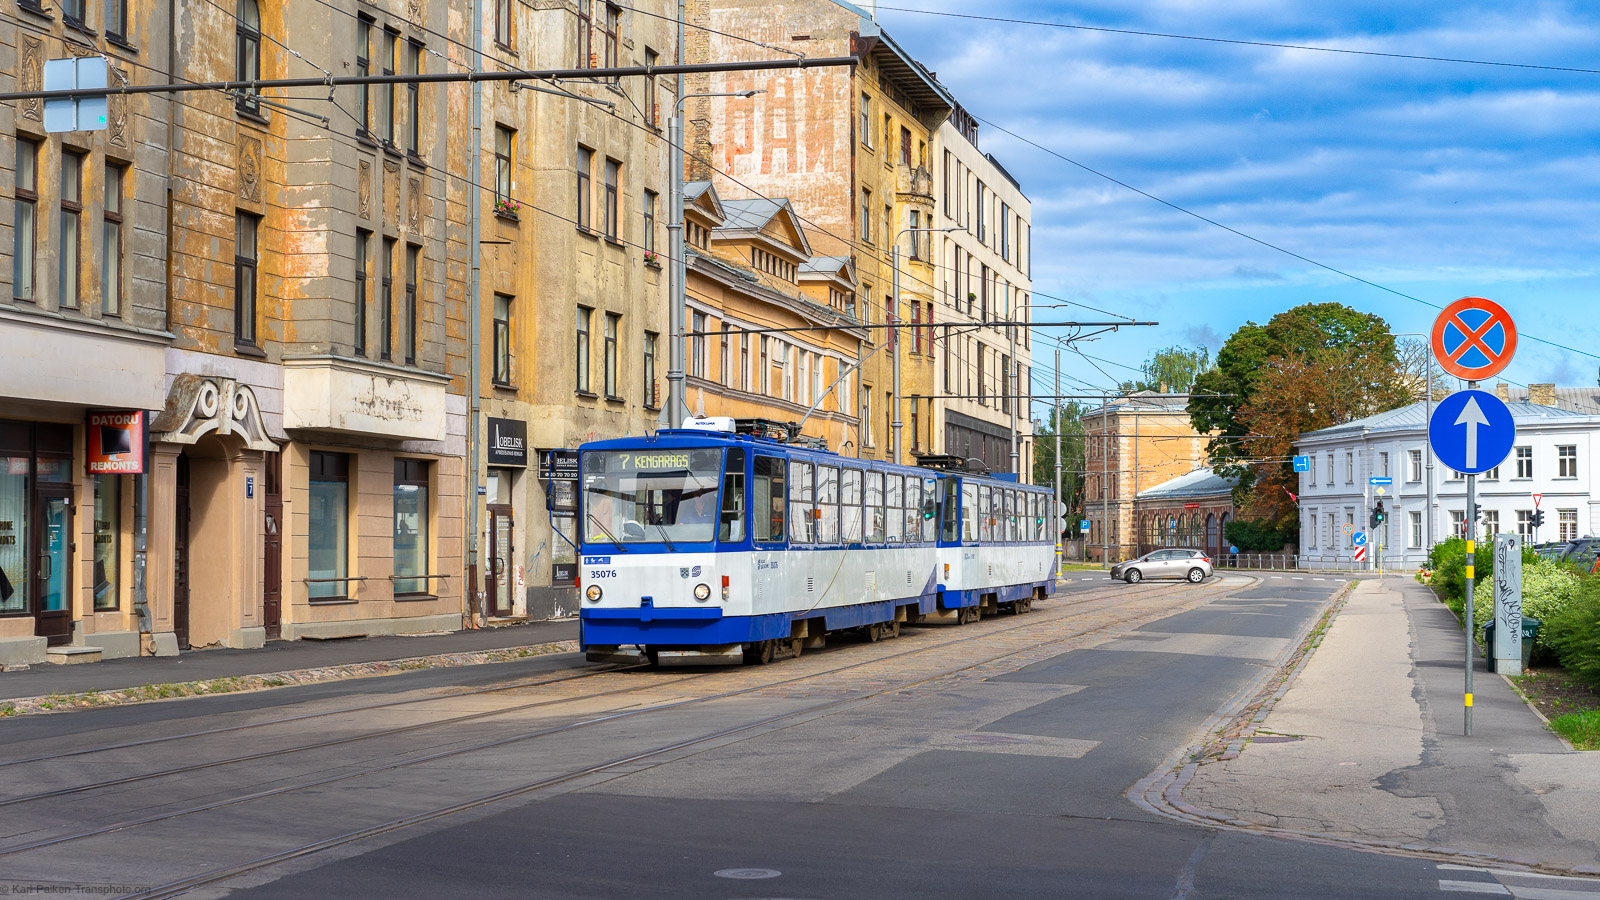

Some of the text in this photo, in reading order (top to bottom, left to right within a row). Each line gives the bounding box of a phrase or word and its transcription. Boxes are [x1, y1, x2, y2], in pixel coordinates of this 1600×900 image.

[92, 415, 139, 425] DATORU
[500, 436, 523, 449] OBELISK
[90, 461, 139, 471] REMONTS
[619, 454, 630, 469] 7
[591, 569, 617, 579] 35076
